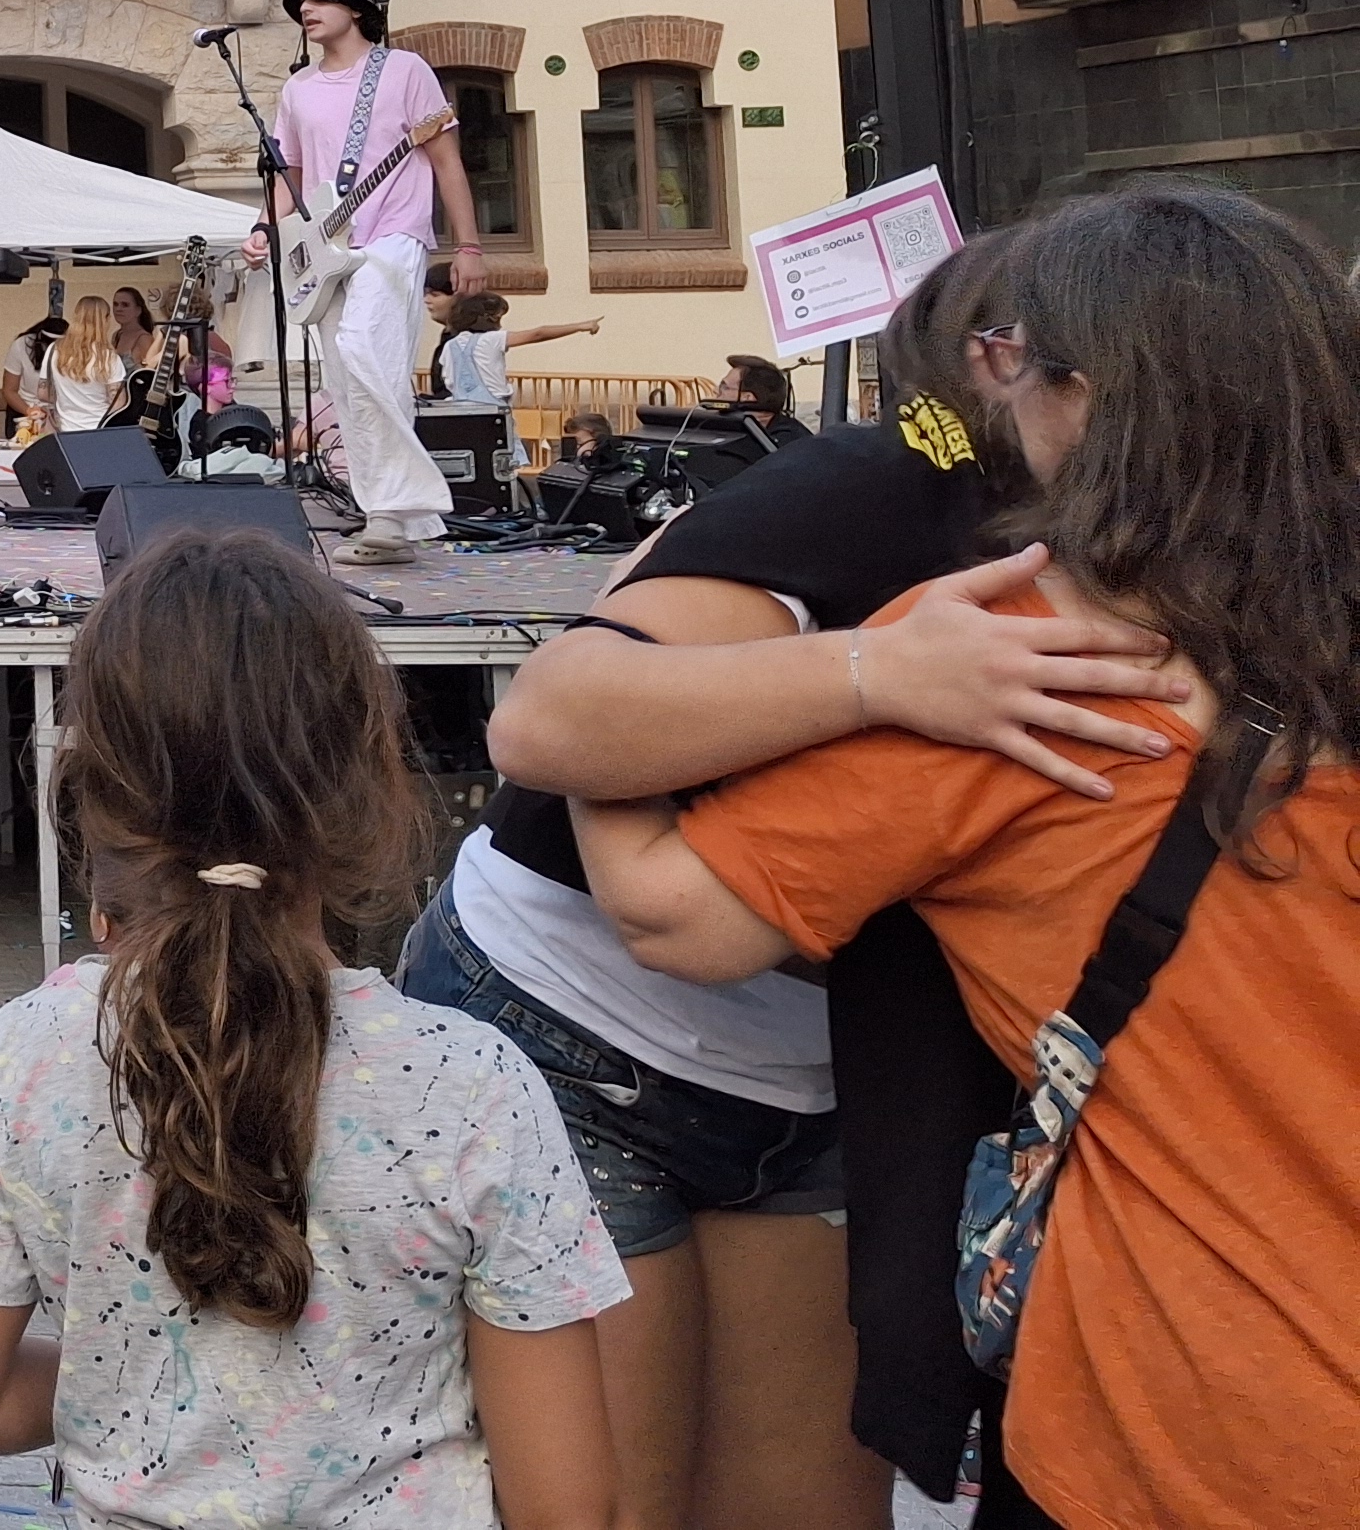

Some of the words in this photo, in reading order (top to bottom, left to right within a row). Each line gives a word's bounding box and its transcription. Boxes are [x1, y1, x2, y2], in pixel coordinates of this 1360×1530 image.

[781, 246, 821, 266] XARXES
[822, 231, 866, 252] SOCIALS
[904, 272, 927, 285] ESCA
